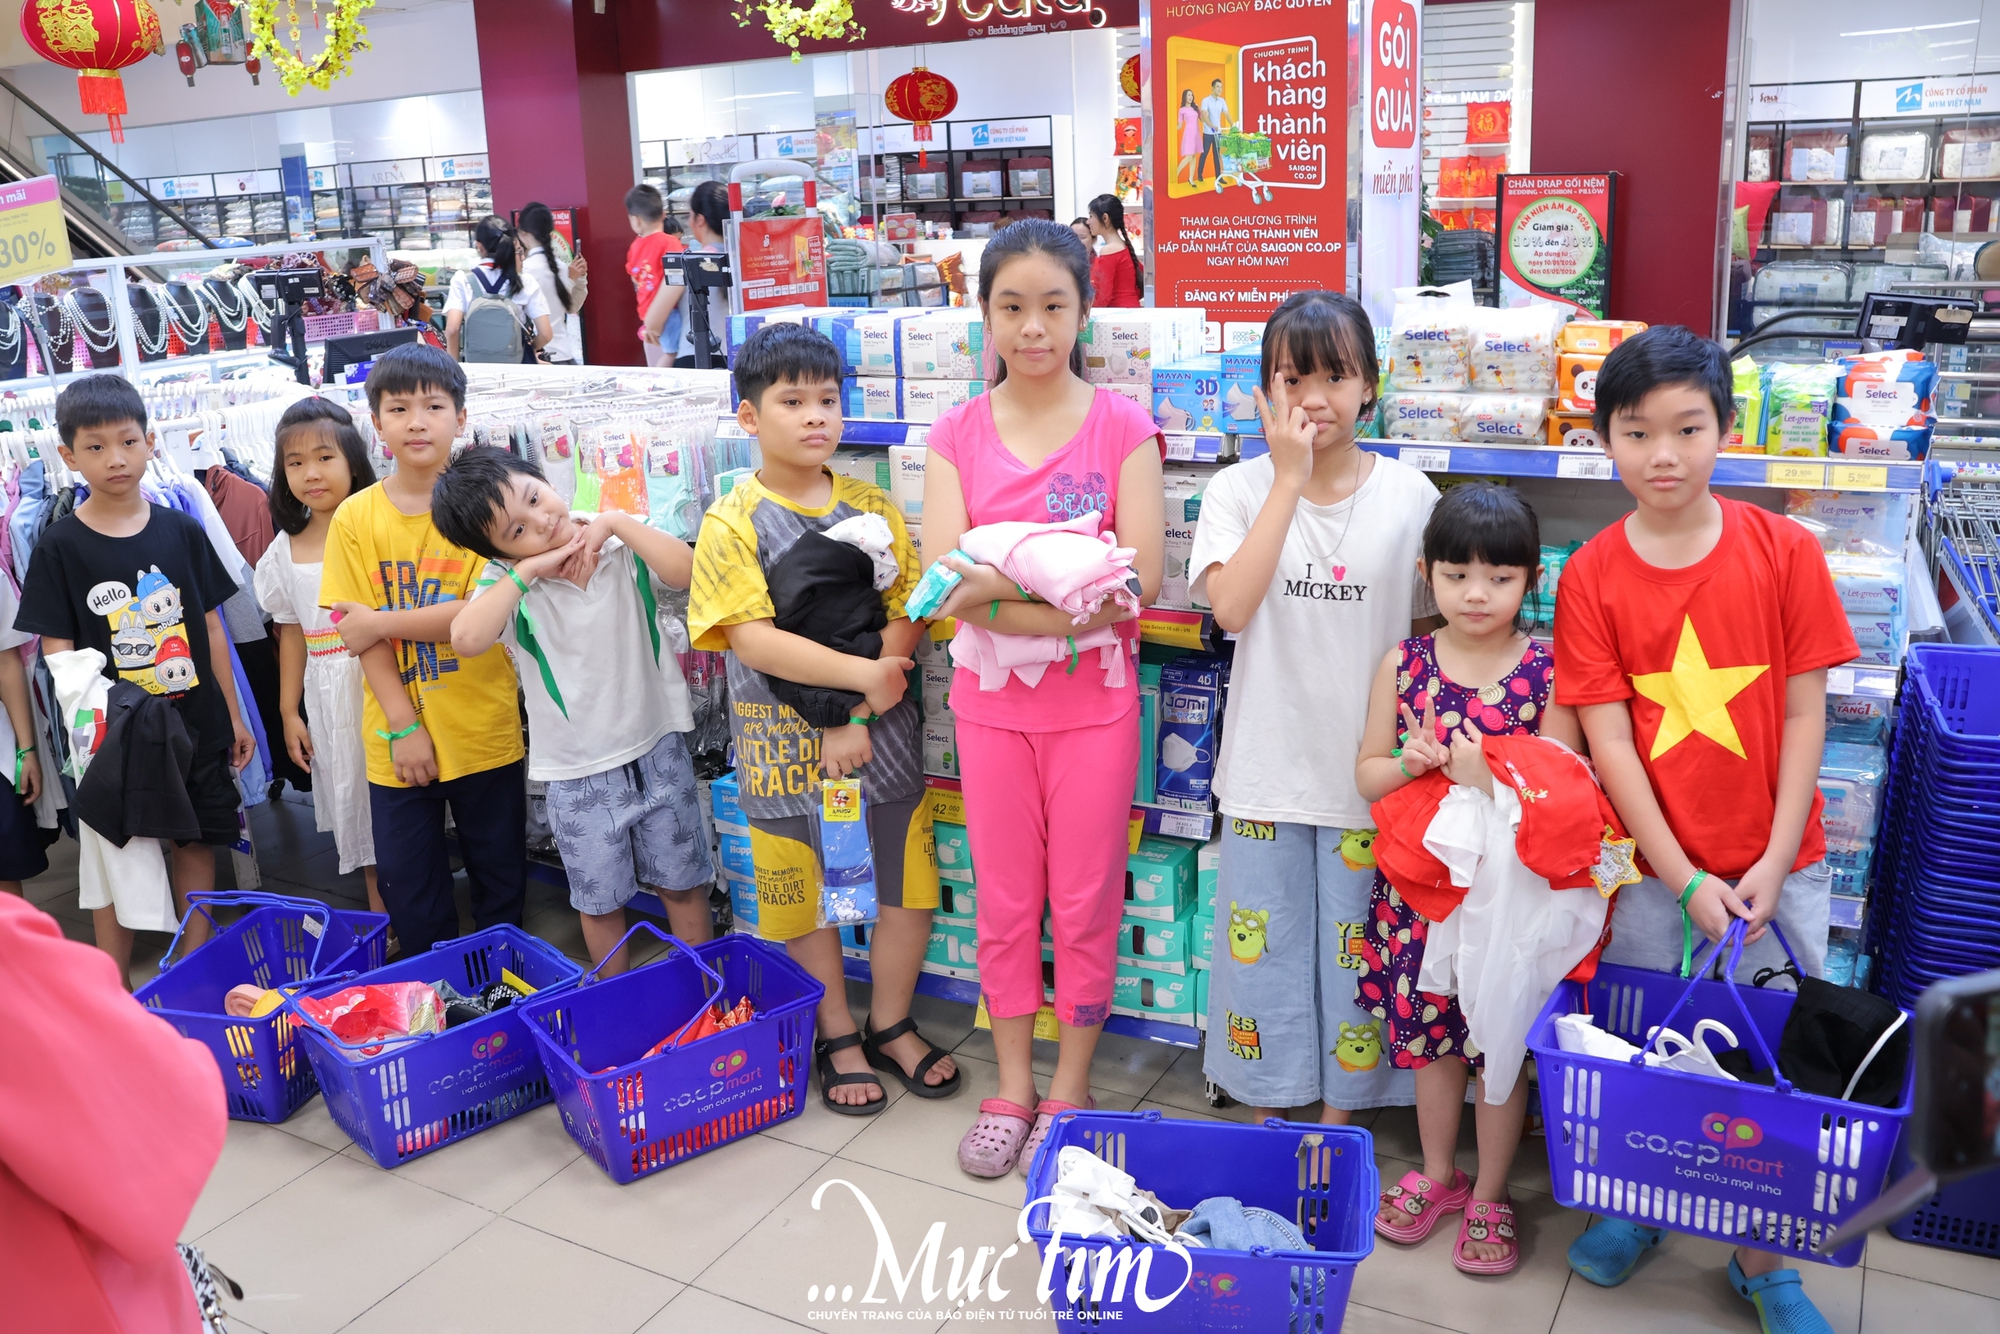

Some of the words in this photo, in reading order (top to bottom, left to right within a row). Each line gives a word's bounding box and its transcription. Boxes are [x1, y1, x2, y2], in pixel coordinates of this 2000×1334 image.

[1217, 2, 1250, 13] NGAY
[988, 25, 1018, 35] Bedding
[1018, 23, 1045, 34] gallery
[1379, 12, 1410, 70] GÓI
[1253, 48, 1285, 59] CHƯƠNG
[1287, 45, 1309, 54] TRÌNH
[1253, 58, 1326, 83] khách
[1268, 82, 1327, 109] hàng
[1375, 77, 1413, 133] QUÀ
[1257, 112, 1326, 135] thành
[1276, 138, 1326, 161] viên
[1288, 164, 1317, 172] SAIGON
[372, 172, 405, 183] ARENA
[1373, 160, 1397, 195] miễn
[1398, 165, 1414, 202] phí
[1508, 178, 1534, 188] CHĂN
[1537, 180, 1562, 188] DRAP
[1564, 177, 1581, 187] GỐI
[1584, 178, 1605, 190] NỆM
[6, 189, 26, 203] mãi
[1180, 216, 1210, 226] THAM
[1212, 216, 1230, 226] GIA
[1232, 215, 1282, 226] CHƯƠNG
[1285, 213, 1317, 225] TRÌNH
[1576, 213, 1591, 231] 2026
[1179, 228, 1217, 240] KHÁCH
[1219, 227, 1250, 239] HÀNG
[1253, 226, 1290, 239] THÀNH
[1293, 226, 1319, 239] VIÊN
[0, 228, 56, 269] 30%
[1158, 240, 1179, 253] HẤP
[1182, 239, 1203, 253] DẪN
[1206, 240, 1233, 252] NHẤT
[1236, 240, 1259, 253] CỦA
[1261, 242, 1303, 253] SAIGON
[1305, 242, 1342, 253] CO.OP
[1207, 256, 1235, 266] NGAY
[1237, 255, 1262, 266] HÔM
[1265, 256, 1289, 266] NAY!
[1185, 288, 1217, 302] ĐĂNG
[1219, 288, 1236, 302] KÝ
[1238, 287, 1267, 302] MIỄN
[1578, 296, 1601, 305] Cotton
[864, 331, 888, 339] Select
[908, 333, 933, 341] Select
[1112, 332, 1138, 340] Select
[1405, 330, 1450, 341] Select
[1485, 340, 1532, 353] Select
[866, 389, 890, 398] Select
[1194, 379, 1220, 396] 3D
[1866, 389, 1898, 399] Select
[910, 391, 934, 400] Select
[1399, 407, 1444, 419] Select
[1784, 414, 1820, 424] Let-green
[543, 425, 562, 434] Select
[1477, 422, 1523, 435] Select
[603, 433, 625, 442] Select
[651, 439, 673, 448] Select
[1859, 446, 1890, 455] Select
[1821, 505, 1859, 516] Let-green
[1305, 563, 1313, 579] I
[1283, 580, 1367, 601] MICKEY
[1847, 589, 1883, 599] Let-green
[92, 588, 126, 609] Hello
[926, 674, 949, 683] Select
[1197, 675, 1212, 686] 4D
[743, 721, 762, 735] are
[767, 718, 810, 738] made
[926, 732, 949, 743] Select
[737, 737, 790, 764] LITTLE
[933, 803, 960, 815] 42.000
[1231, 818, 1275, 841] CAN
[771, 866, 803, 875] MEMORIES
[781, 879, 805, 892] DIRT
[757, 892, 805, 906] TRACKS
[1225, 1008, 1257, 1032] YES
[1227, 1037, 1262, 1060] CAN
[725, 1067, 763, 1090] mart
[1723, 1152, 1784, 1179] mart
[1704, 1171, 1728, 1184] của
